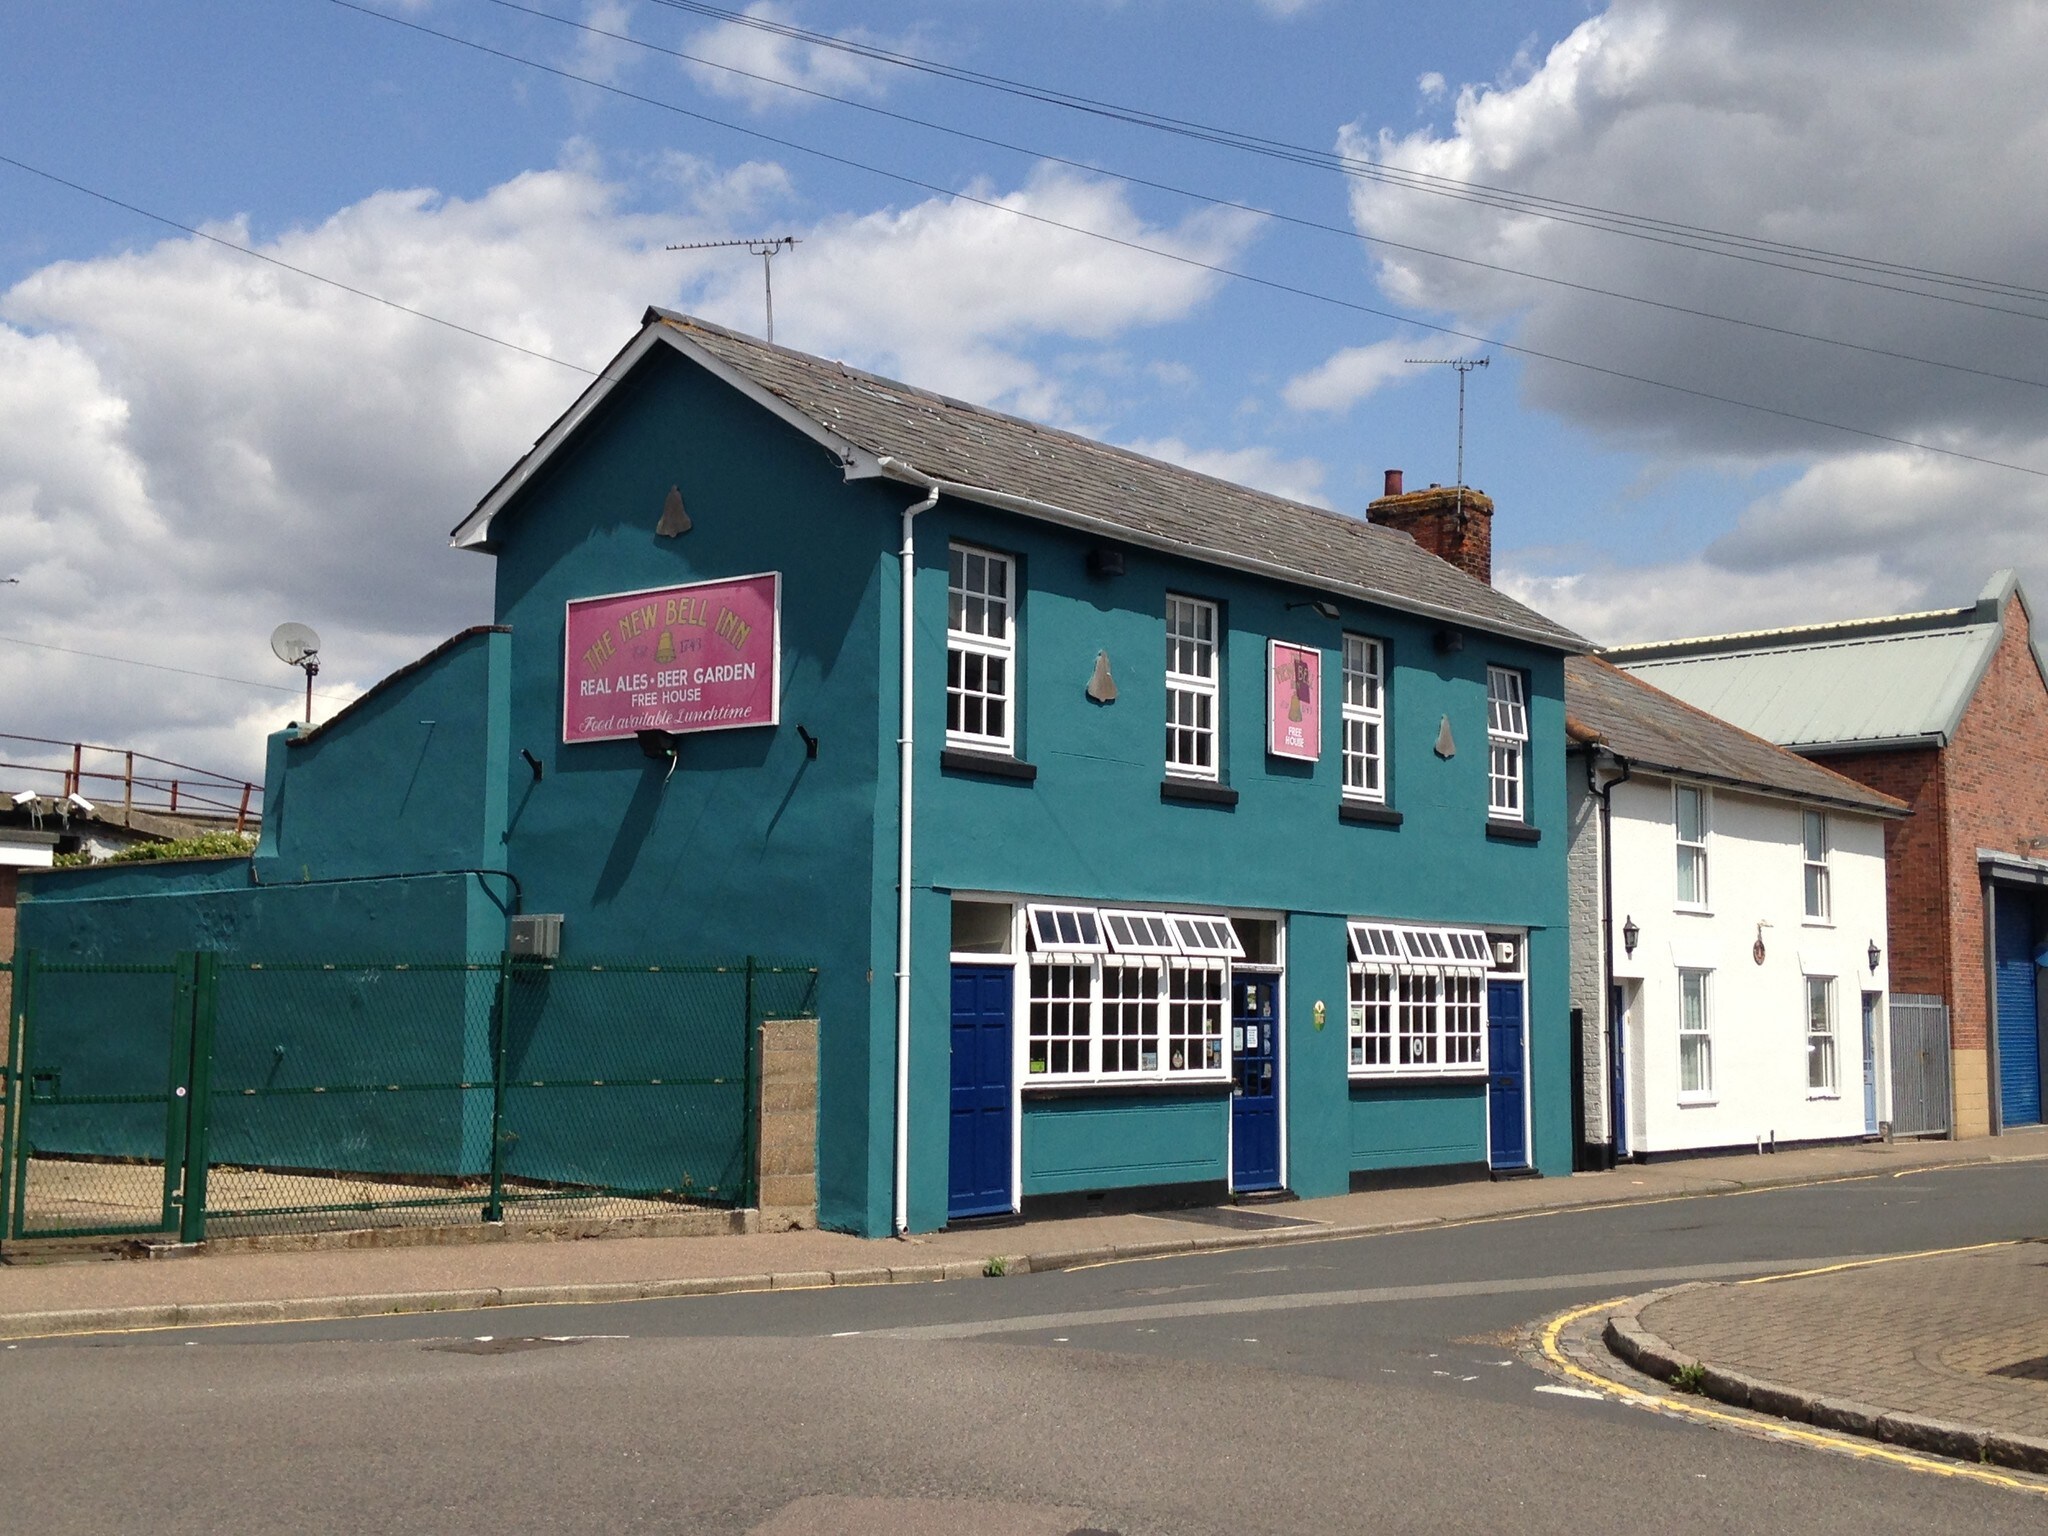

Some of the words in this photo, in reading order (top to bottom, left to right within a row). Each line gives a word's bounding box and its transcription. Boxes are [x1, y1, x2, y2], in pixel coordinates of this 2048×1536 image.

[581, 628, 617, 672] THE
[618, 602, 659, 642] NEW
[665, 597, 707, 627] BELL
[714, 605, 752, 651] INN
[580, 677, 611, 696] REAL
[616, 673, 648, 692] ALES
[657, 669, 688, 688] BEER
[693, 662, 755, 684] GARDEN
[631, 691, 657, 707] FREE
[662, 687, 701, 704] HOUSE
[580, 715, 615, 733] Food
[616, 709, 673, 730] available
[673, 703, 752, 724] Lunchtime
[1288, 726, 1303, 738] FREE
